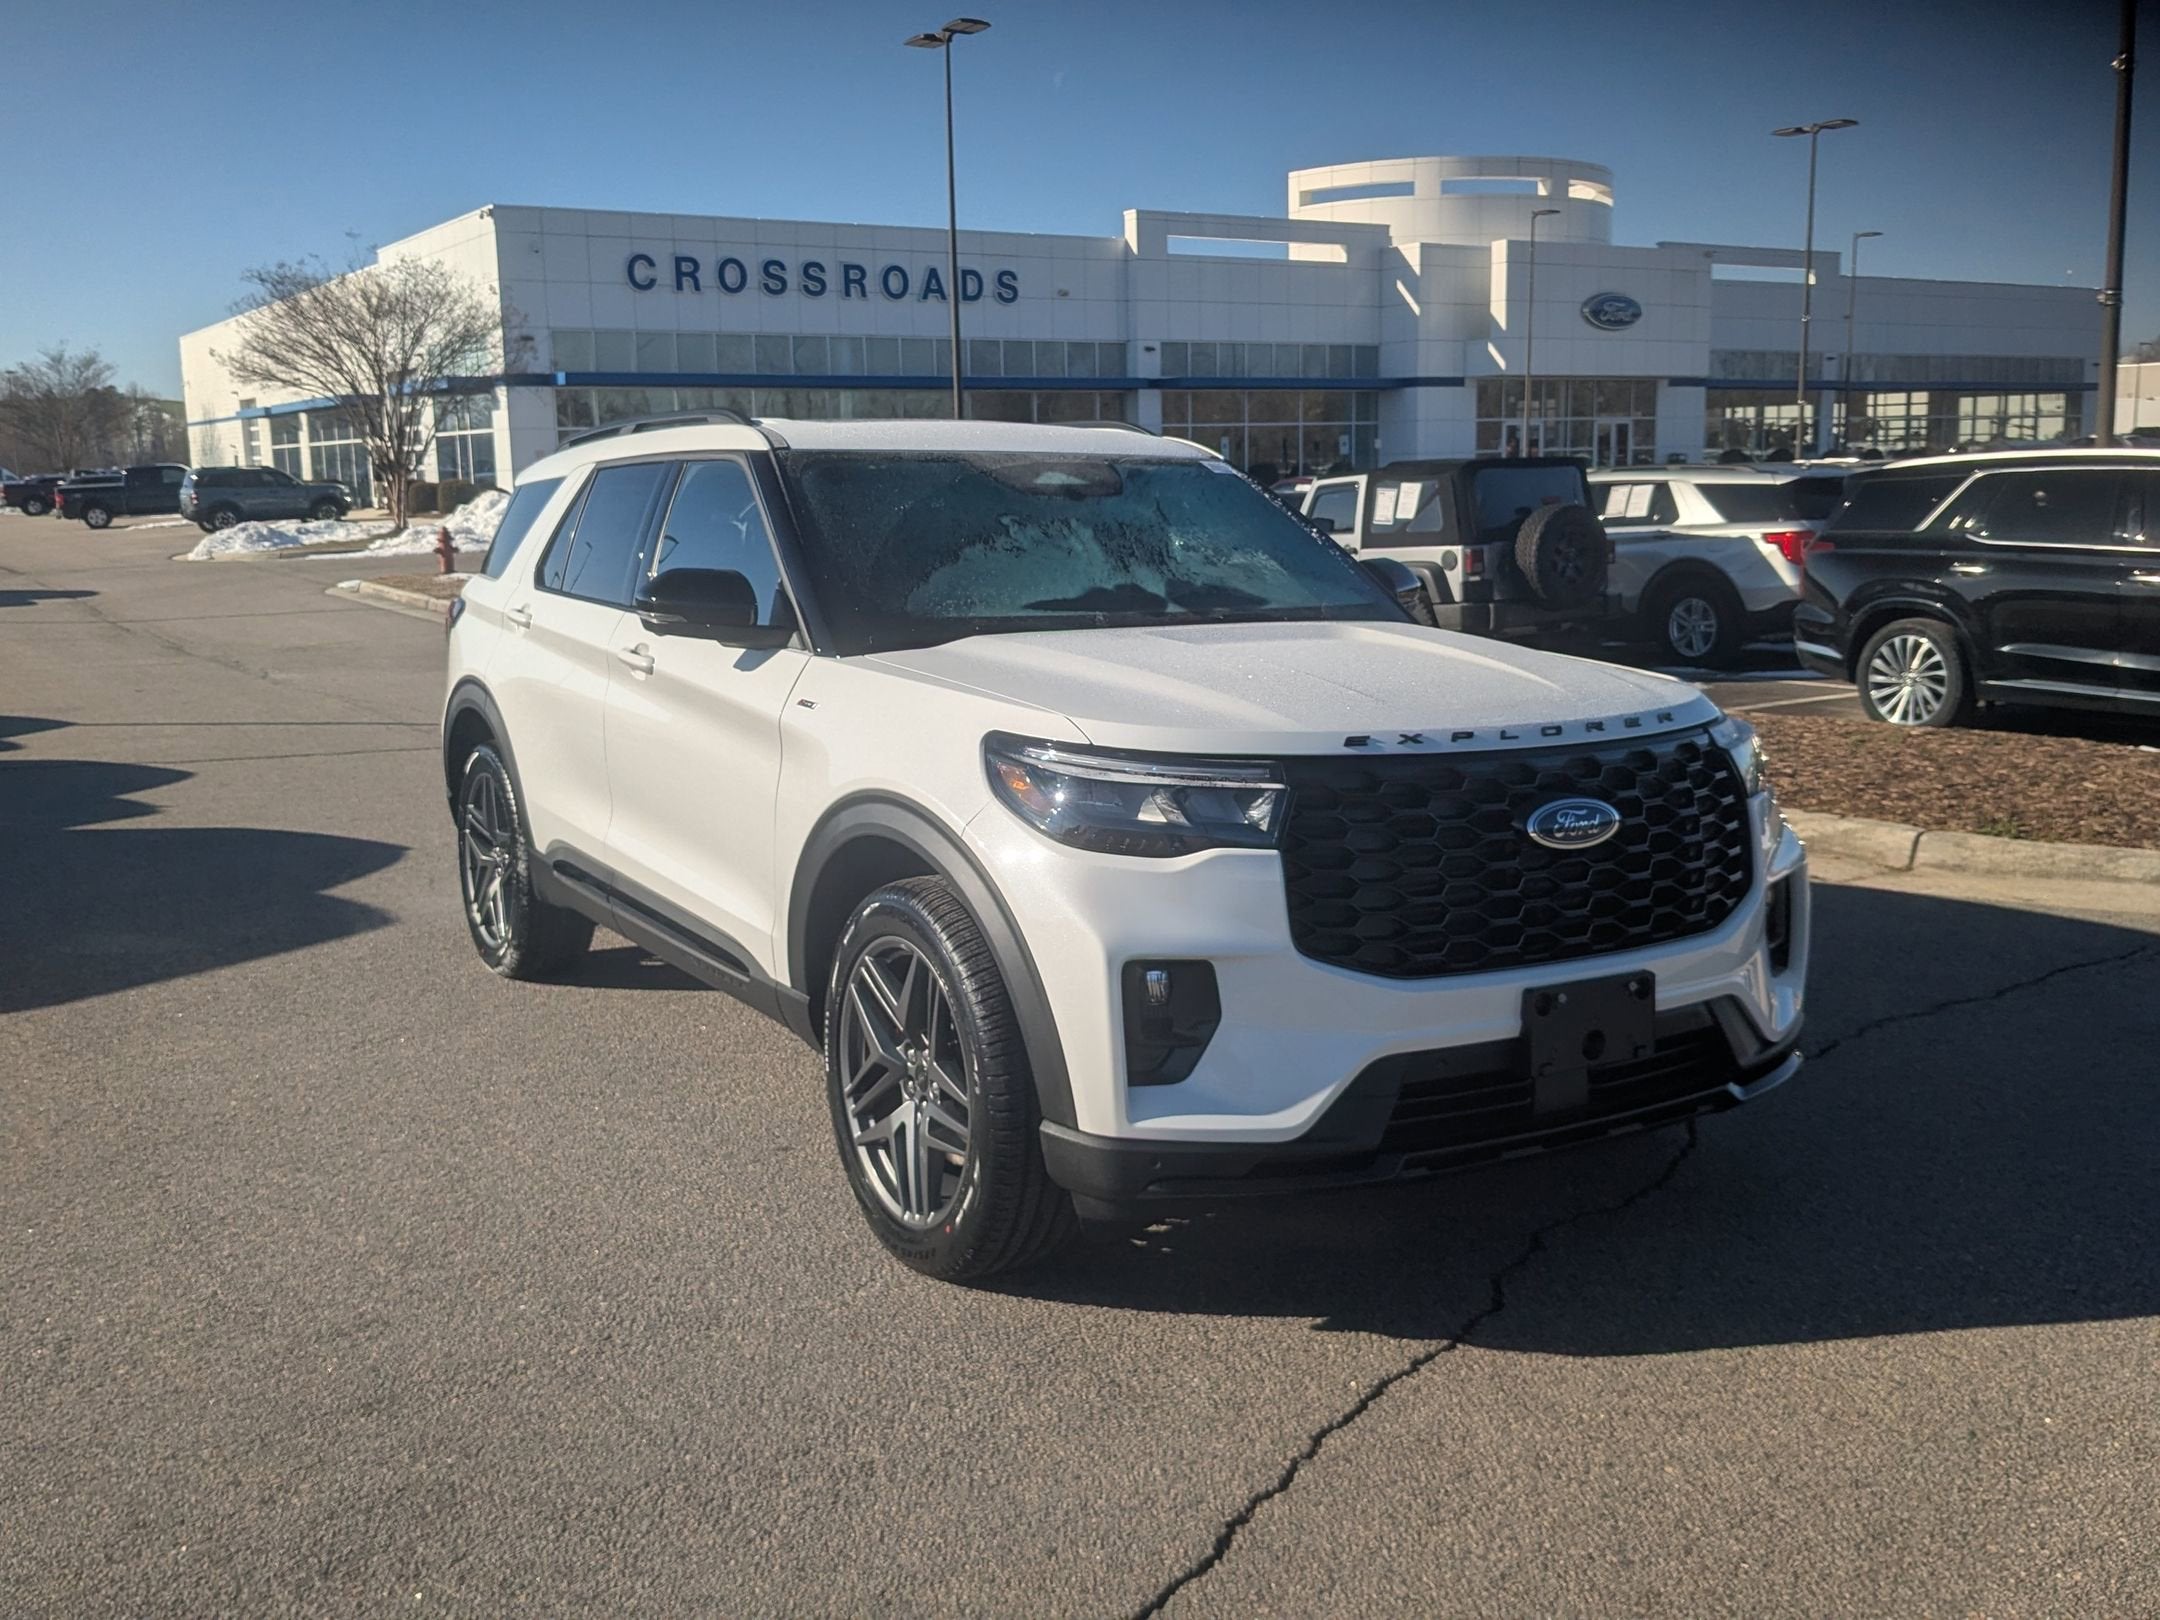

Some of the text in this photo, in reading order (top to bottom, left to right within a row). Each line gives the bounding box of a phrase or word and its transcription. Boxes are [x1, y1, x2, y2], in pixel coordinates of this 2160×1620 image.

[627, 252, 1020, 304] CROSSROADS
[1343, 711, 1675, 748] EXPLORER
[1553, 808, 1601, 839] Ford
